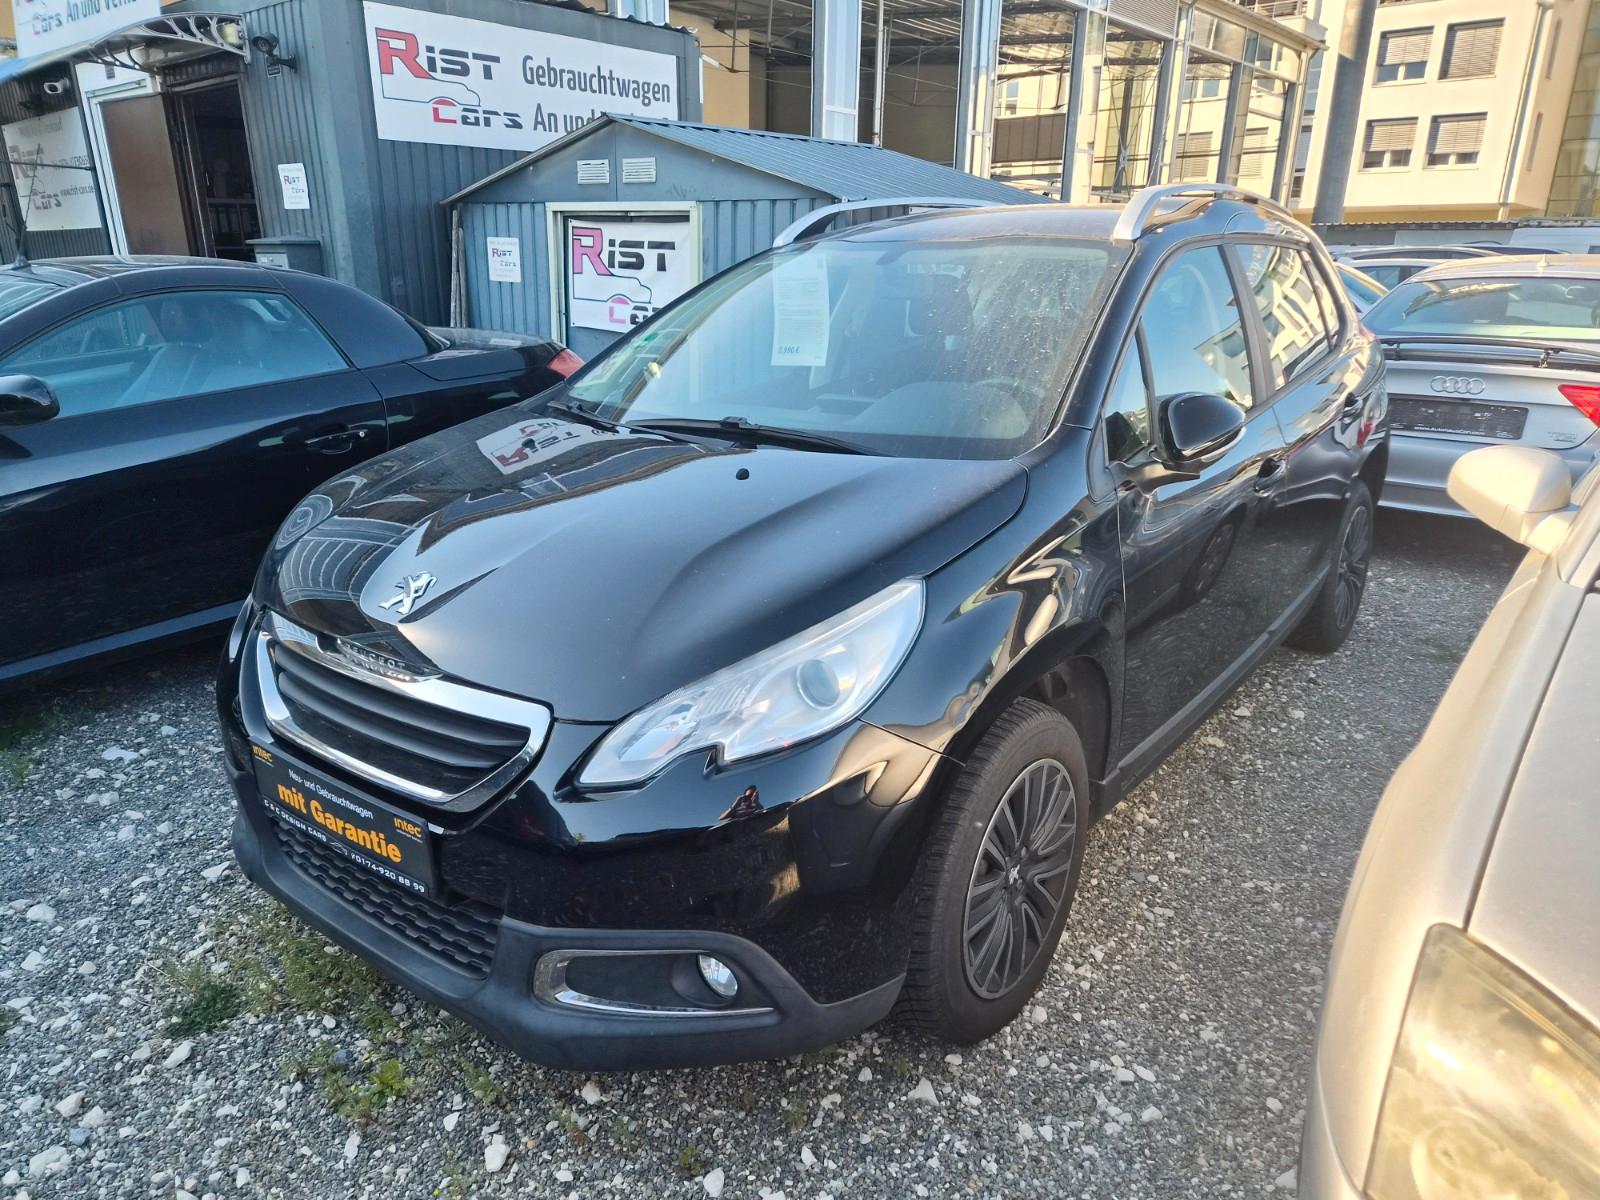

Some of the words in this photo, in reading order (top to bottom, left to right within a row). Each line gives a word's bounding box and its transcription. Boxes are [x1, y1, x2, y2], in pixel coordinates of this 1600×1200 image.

[522, 54, 671, 107] Gebrauchtwagen
[533, 102, 559, 133] An
[608, 296, 663, 326] Ca
[304, 778, 316, 792] und
[315, 784, 374, 820] Gebrauchtwagen
[276, 783, 308, 815] mit
[309, 799, 402, 863] Garantie
[280, 810, 307, 831] DESIGN
[307, 826, 328, 842] CARS
